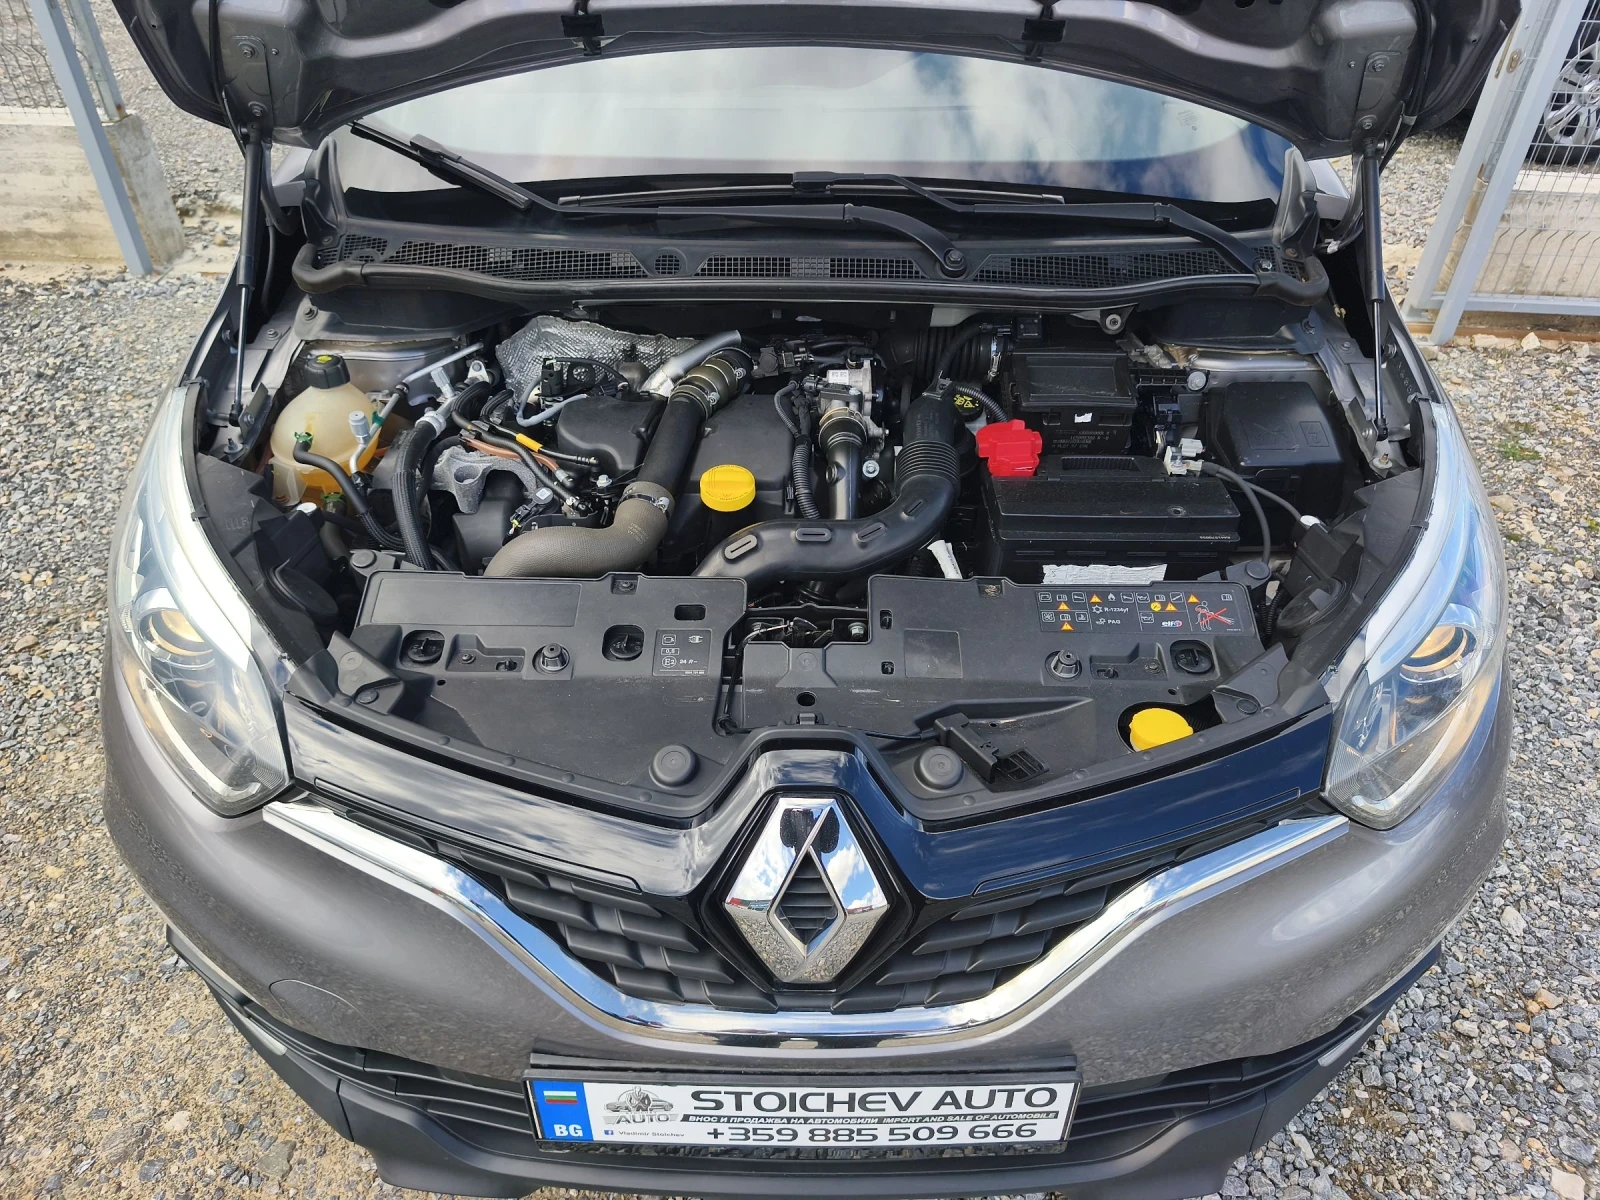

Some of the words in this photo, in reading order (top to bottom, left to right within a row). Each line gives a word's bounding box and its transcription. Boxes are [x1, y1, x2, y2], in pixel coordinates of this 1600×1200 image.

[690, 1089, 923, 1114] STOICHEV
[932, 1086, 1058, 1111] AUTO
[615, 1113, 670, 1125] AUTO
[688, 1115, 718, 1123] ВНОС
[882, 1116, 922, 1124] IMPORT
[990, 1112, 1057, 1120] AUTOMOBILE
[553, 1124, 584, 1138] BG
[706, 1126, 799, 1142] +359
[808, 1127, 879, 1142] 885
[888, 1125, 959, 1141] 509
[968, 1122, 1038, 1140] 666
